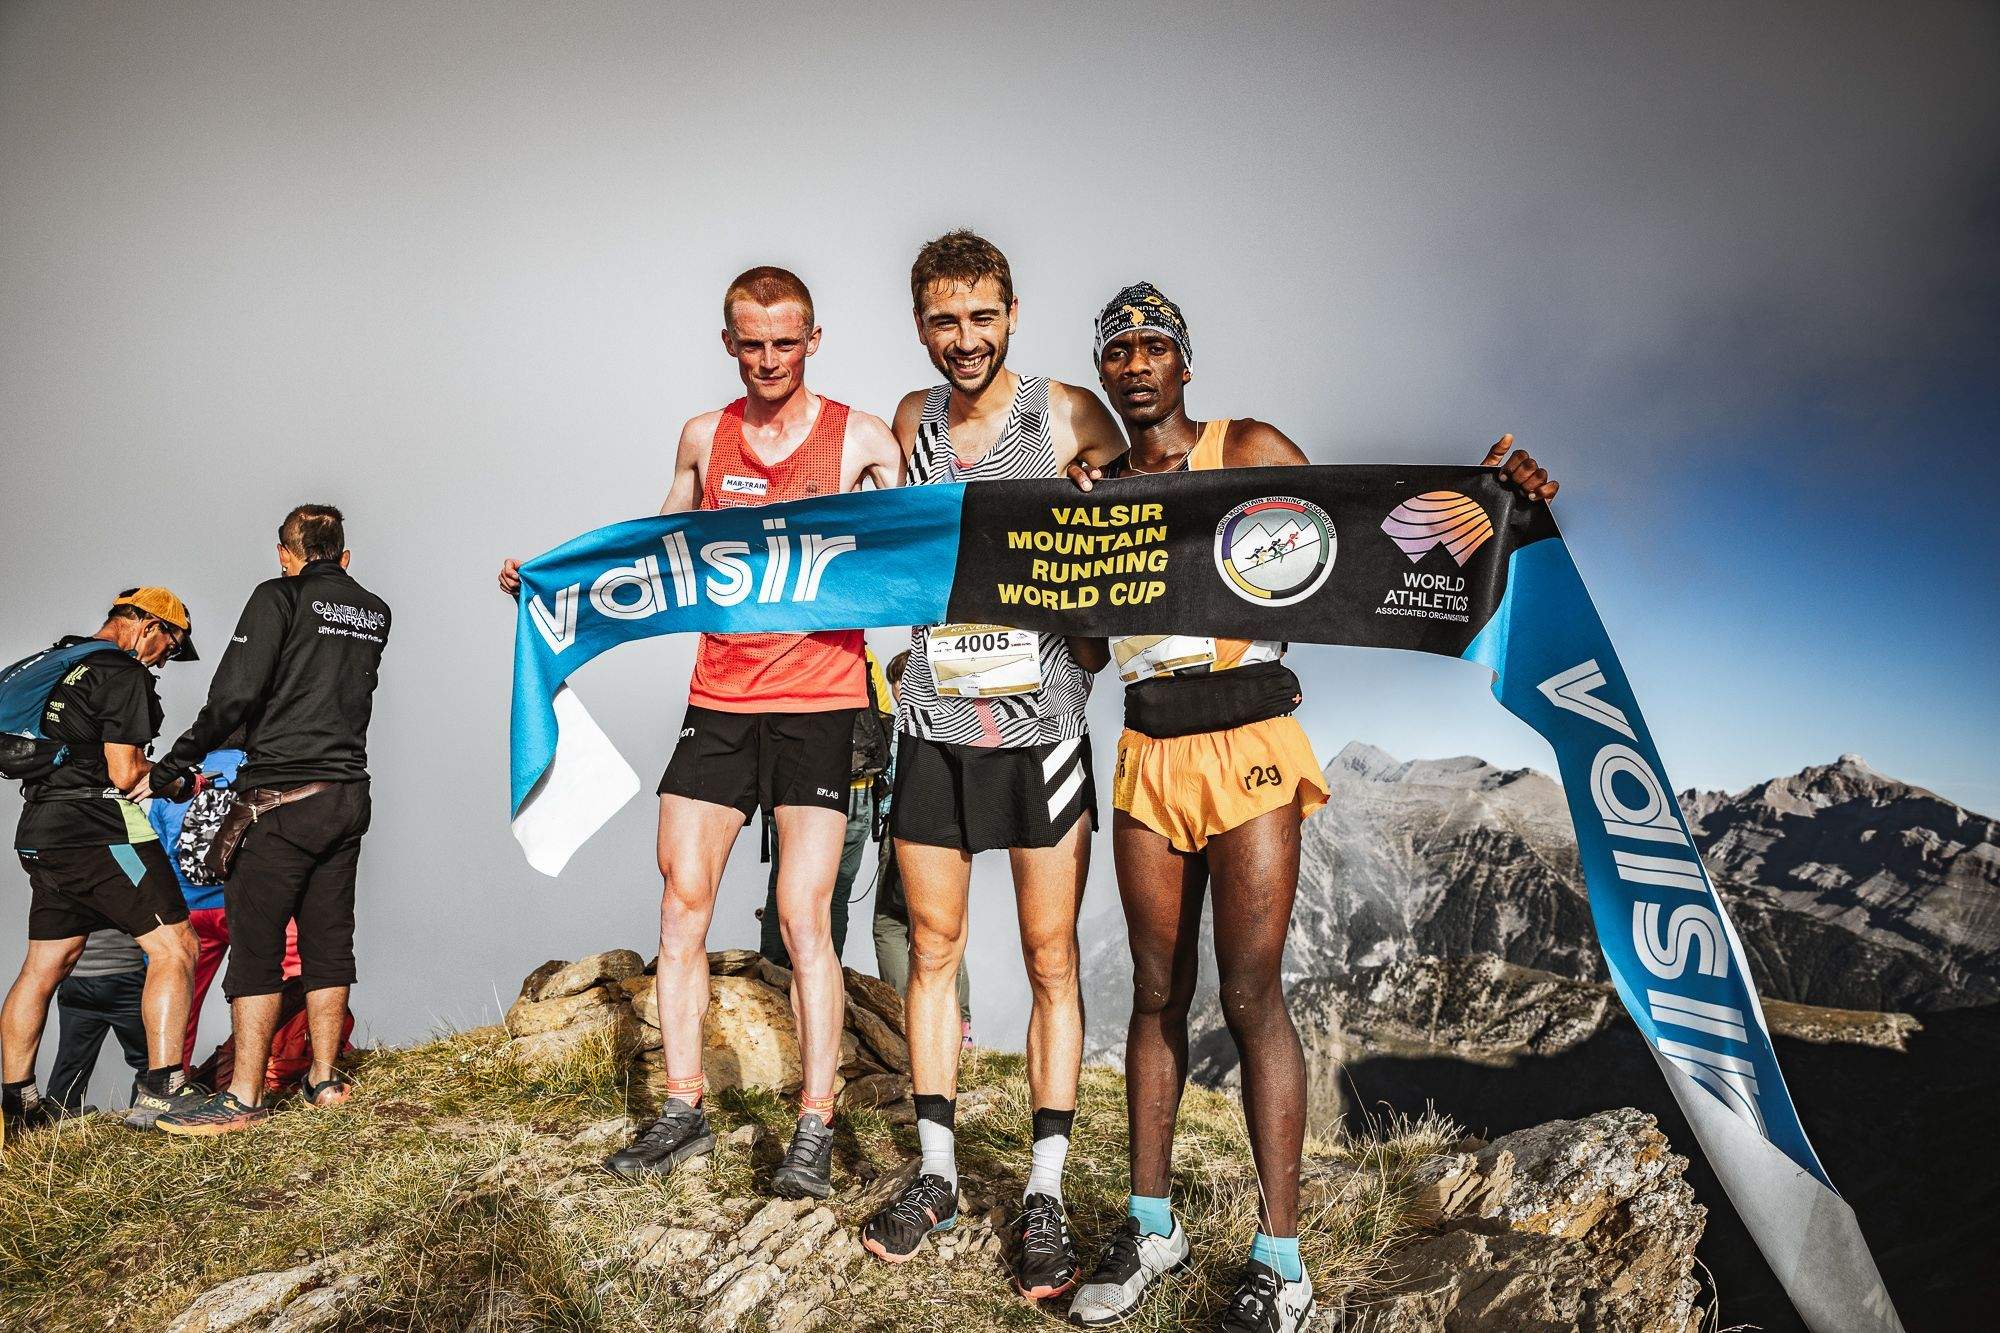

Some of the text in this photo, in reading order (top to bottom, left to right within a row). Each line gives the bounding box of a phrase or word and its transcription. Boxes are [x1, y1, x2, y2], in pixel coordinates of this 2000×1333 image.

[726, 479, 767, 490] MAR-TRAIN
[1051, 503, 1163, 527] VALSIR
[1216, 496, 1336, 539] WORLD MOUNTAIN RUNNING ASSOCIATION
[1007, 525, 1168, 556] MOUNTAIN
[1031, 549, 1169, 584] RUNNING
[528, 518, 856, 656] valsir
[1403, 572, 1465, 592] WORLD
[997, 580, 1167, 611] WORLD CUP
[1383, 589, 1469, 612] ATHLETICS
[323, 611, 378, 631] CANFRANC
[1375, 606, 1428, 618] ASSOCIATED
[954, 632, 1010, 653] 4005
[1243, 763, 1282, 791] r2g
[141, 1096, 172, 1112] HOKA
